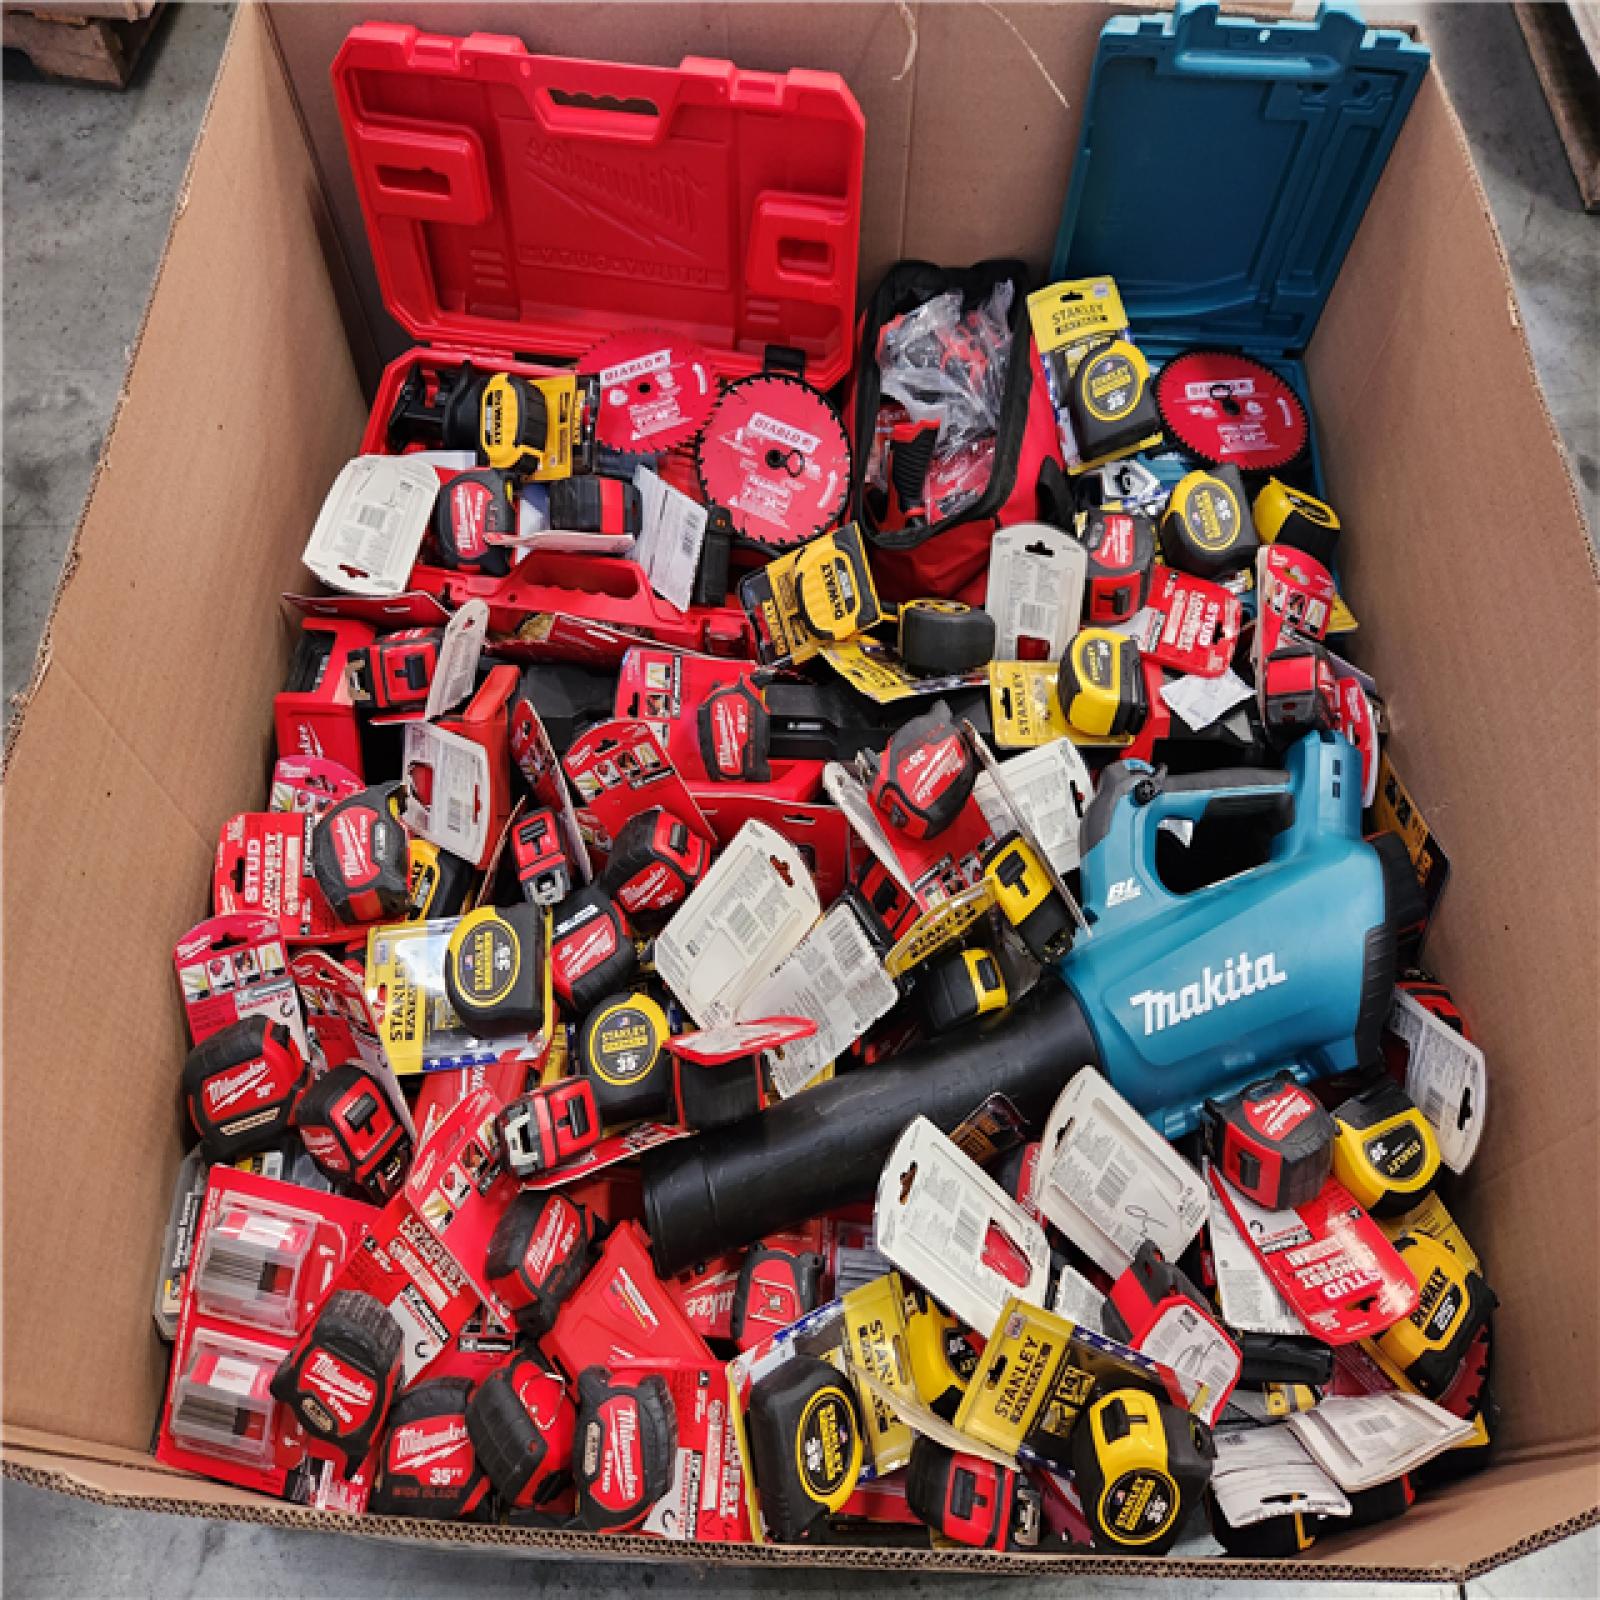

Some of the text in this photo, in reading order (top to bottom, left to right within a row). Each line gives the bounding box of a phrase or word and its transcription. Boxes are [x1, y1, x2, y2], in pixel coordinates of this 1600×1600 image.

[604, 358, 653, 381] DIABLO
[754, 418, 801, 444] DIABLO
[819, 562, 845, 621] DEWALT
[1012, 673, 1029, 736] STANLEY
[245, 839, 260, 902] STUD
[1105, 877, 1139, 902] BL
[203, 1057, 271, 1103] Milwaukee
[1323, 1267, 1382, 1300] STUD
[308, 1351, 376, 1408] Milwaukee
[991, 1335, 1041, 1419] STANLEY
[603, 1451, 612, 1492] STUD
[619, 1406, 641, 1499] Milwaukee
